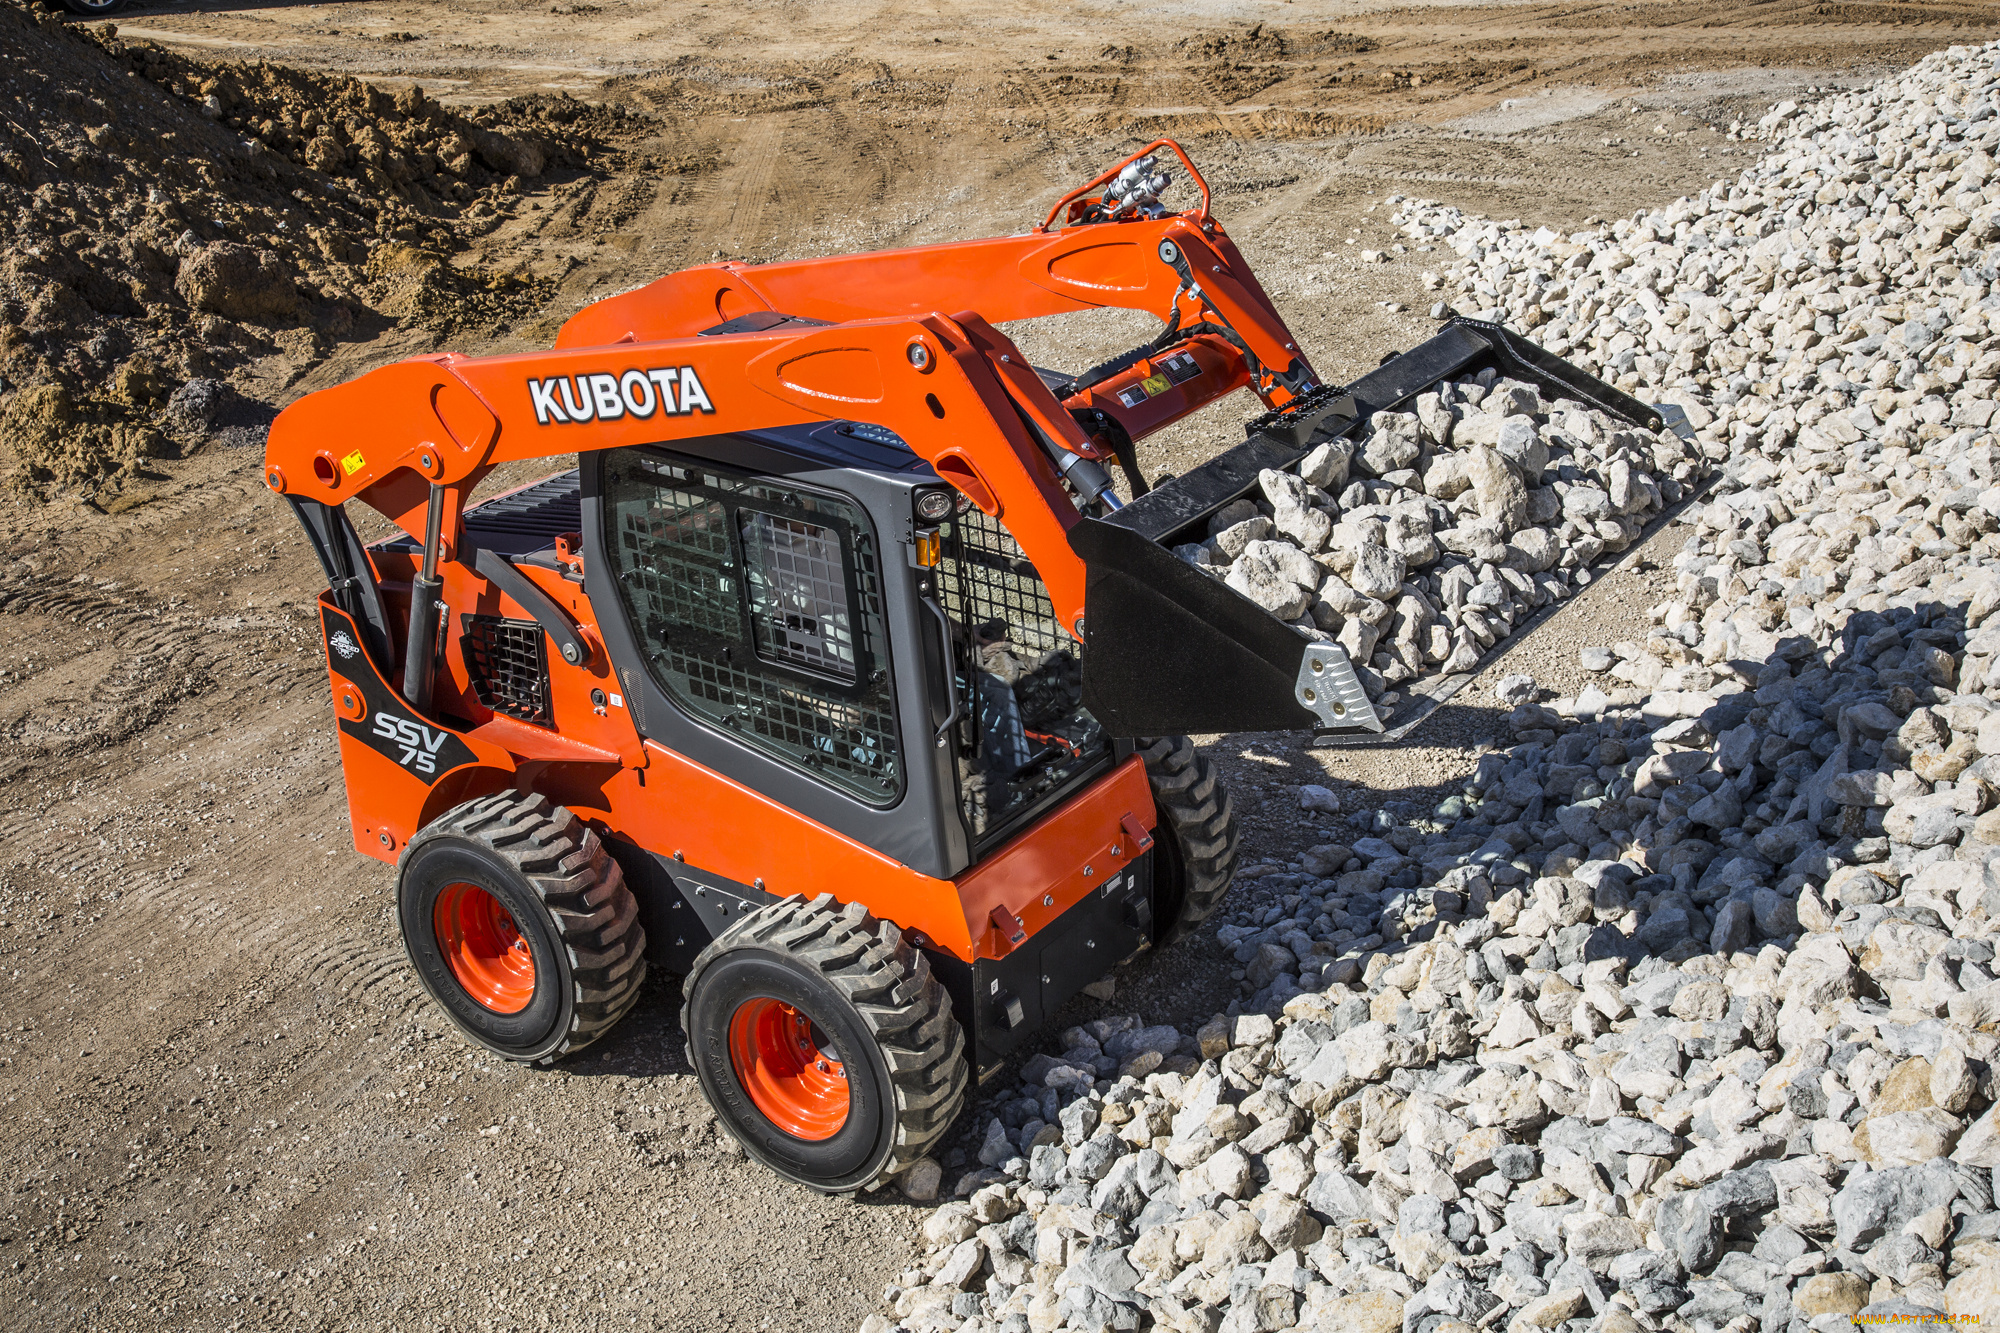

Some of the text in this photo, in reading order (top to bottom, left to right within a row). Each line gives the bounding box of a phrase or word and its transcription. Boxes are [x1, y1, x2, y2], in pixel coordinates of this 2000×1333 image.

[527, 365, 716, 425] KUBOTA
[330, 636, 339, 647] 2
[372, 711, 449, 754] SSV
[398, 743, 437, 774] 75
